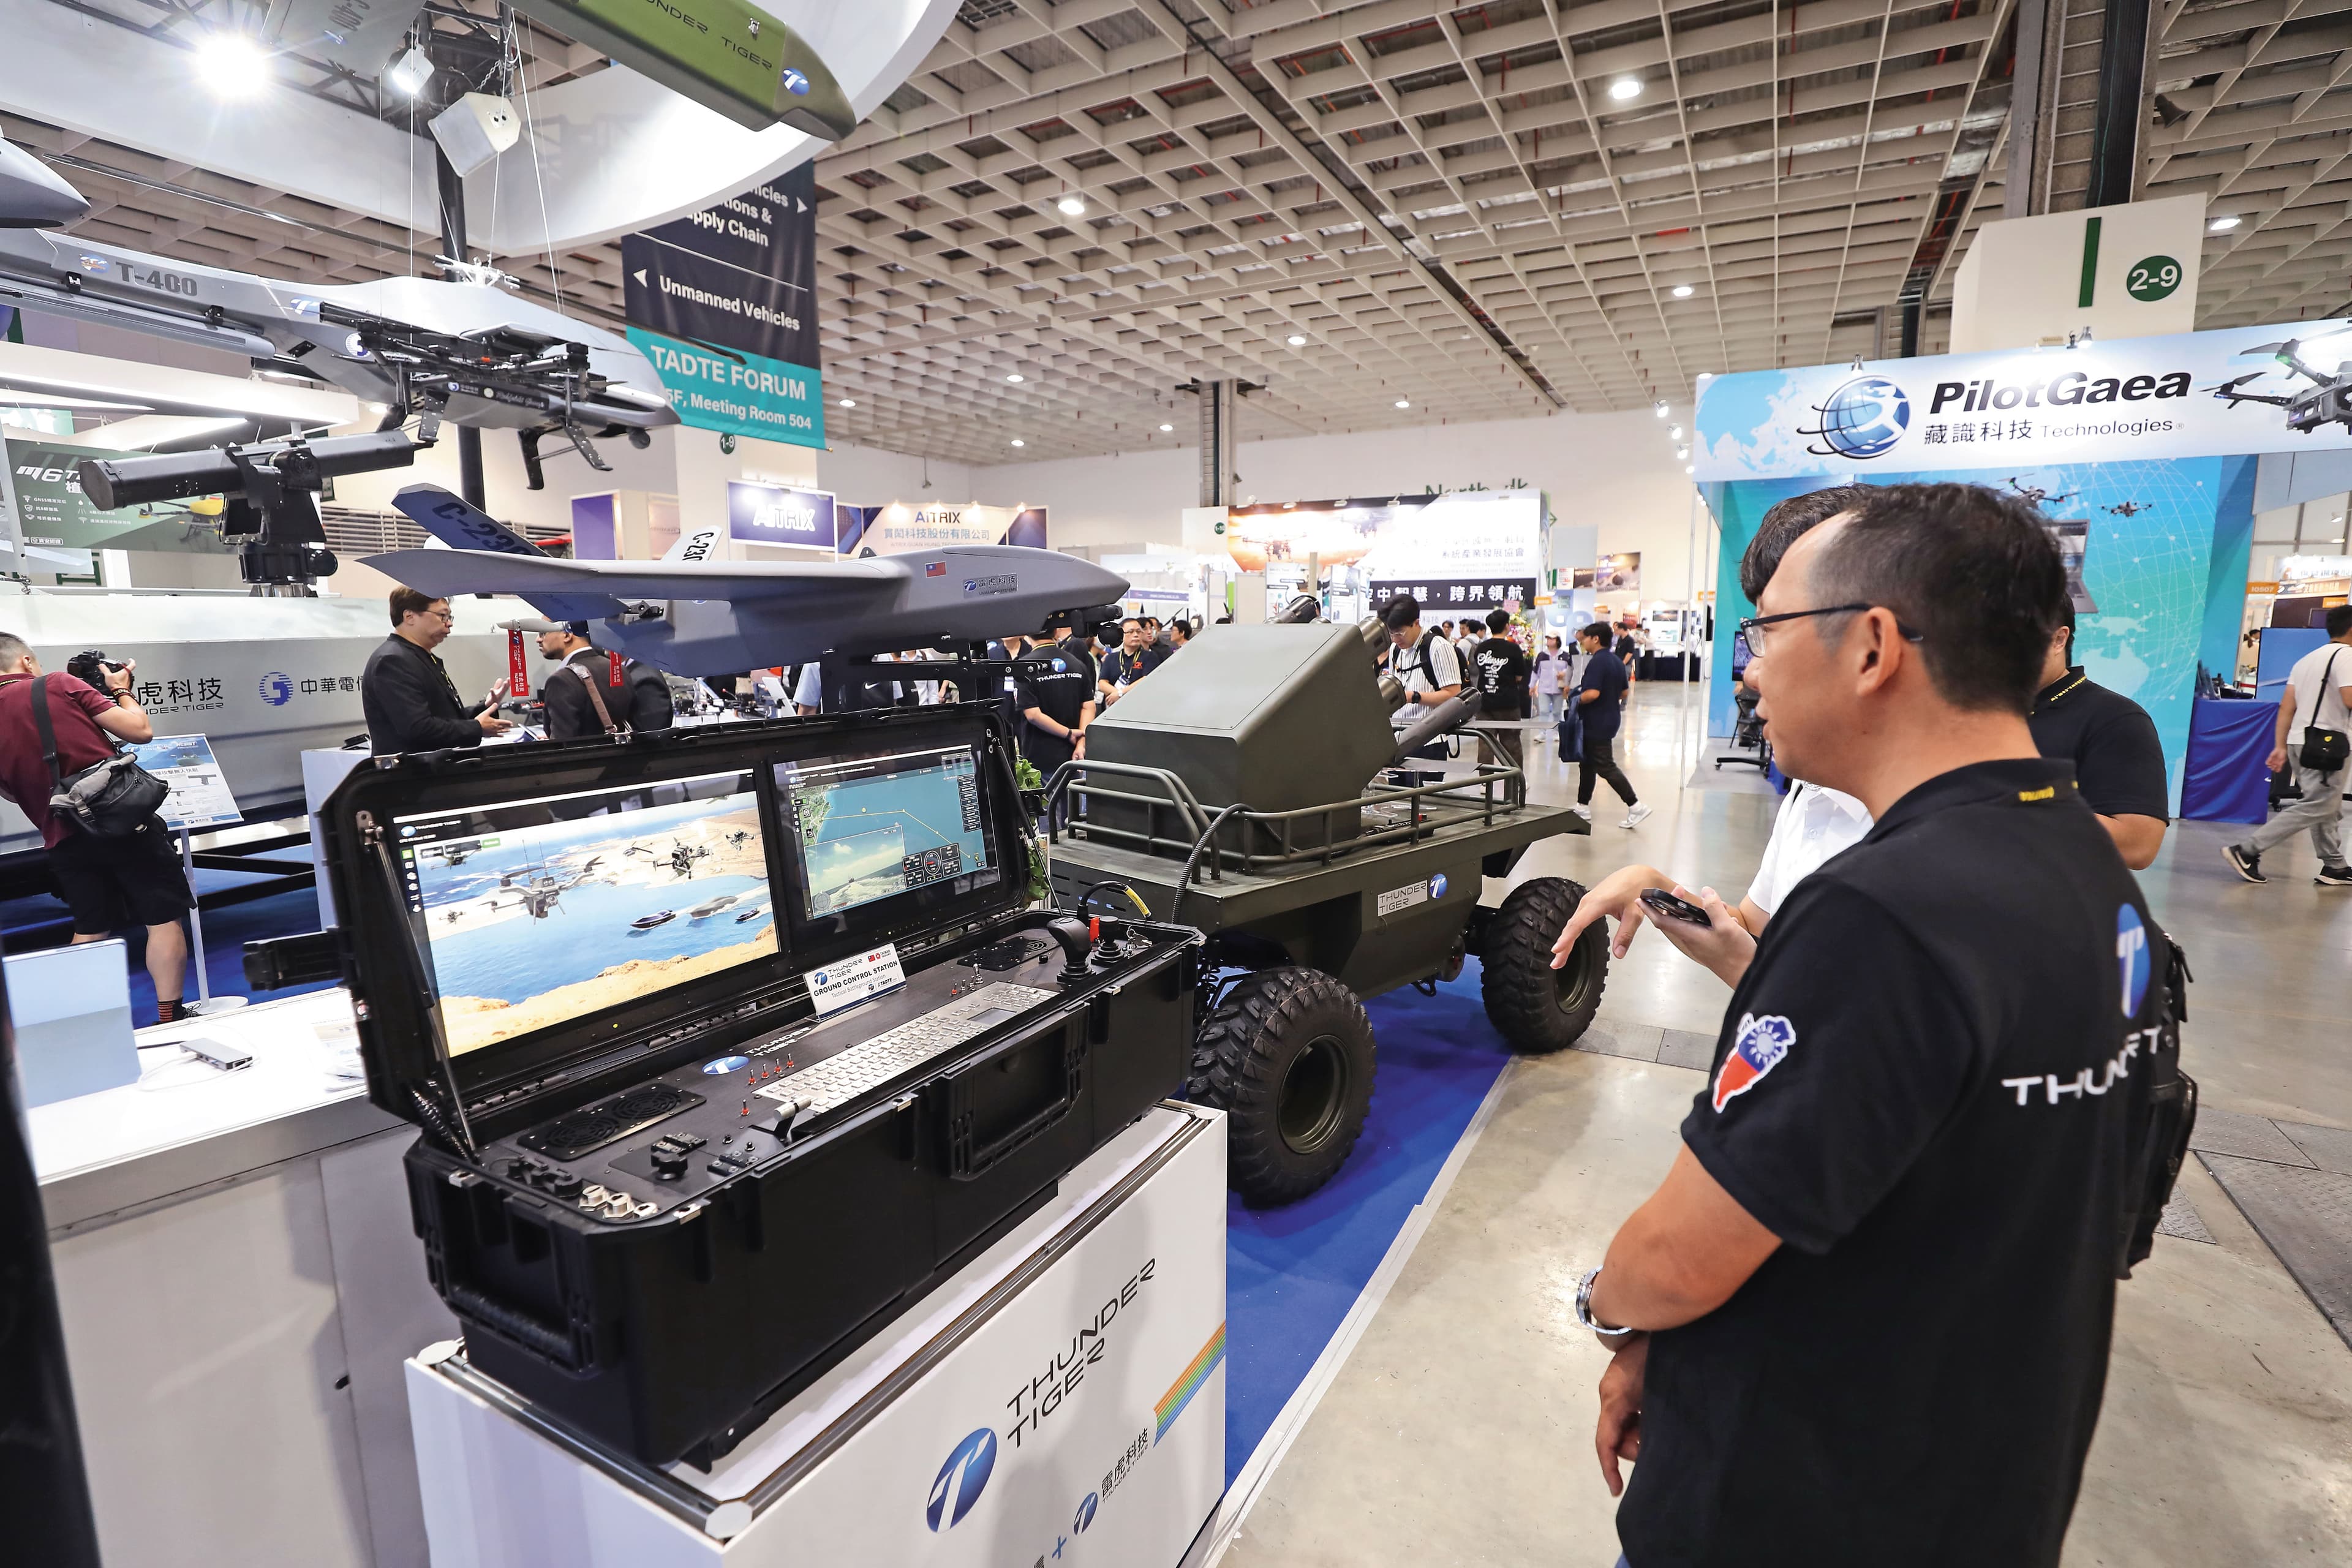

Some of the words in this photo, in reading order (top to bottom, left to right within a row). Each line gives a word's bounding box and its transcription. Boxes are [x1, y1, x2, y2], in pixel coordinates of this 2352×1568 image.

[721, 36, 772, 70] TIGER
[686, 211, 725, 234] pply
[728, 219, 769, 247] Chain
[761, 208, 773, 225] &
[116, 262, 197, 296] T-400
[2130, 265, 2179, 291] 2-9
[659, 274, 741, 314] Unmanned
[742, 300, 801, 331] Vehicles
[650, 345, 725, 383] TADTE
[731, 364, 807, 401] FORUM
[1929, 372, 2192, 414] PilotGaea
[690, 393, 746, 420] Meeting
[749, 405, 786, 425] Room
[788, 413, 813, 429] 504
[720, 435, 735, 449] 1-9
[1924, 420, 2034, 445] 藏識科技
[2042, 418, 2173, 439] Technologies
[978, 575, 1016, 588] 雷虎科技
[183, 702, 224, 712] TIGER
[1379, 882, 1427, 903] THUNDER
[1379, 898, 1409, 913] TIGER
[813, 982, 842, 997] GROUND
[843, 971, 872, 986] CONTROL
[873, 960, 898, 974] STATION
[827, 959, 862, 974] THUNDER
[829, 968, 852, 980] TIGER
[831, 988, 846, 998] Tactical
[847, 979, 872, 993] Battleground
[872, 974, 886, 983] Station
[880, 978, 892, 986] TADTE
[744, 1027, 811, 1054] THUNDER
[753, 1038, 797, 1057] TIGER
[1006, 1257, 1156, 1418] THUNDER
[1007, 1337, 1105, 1449] TIGER
[1101, 1427, 1148, 1498] 雷虎科技
[1102, 1466, 1131, 1504] THUNDER
[1132, 1444, 1148, 1466] TIGER
